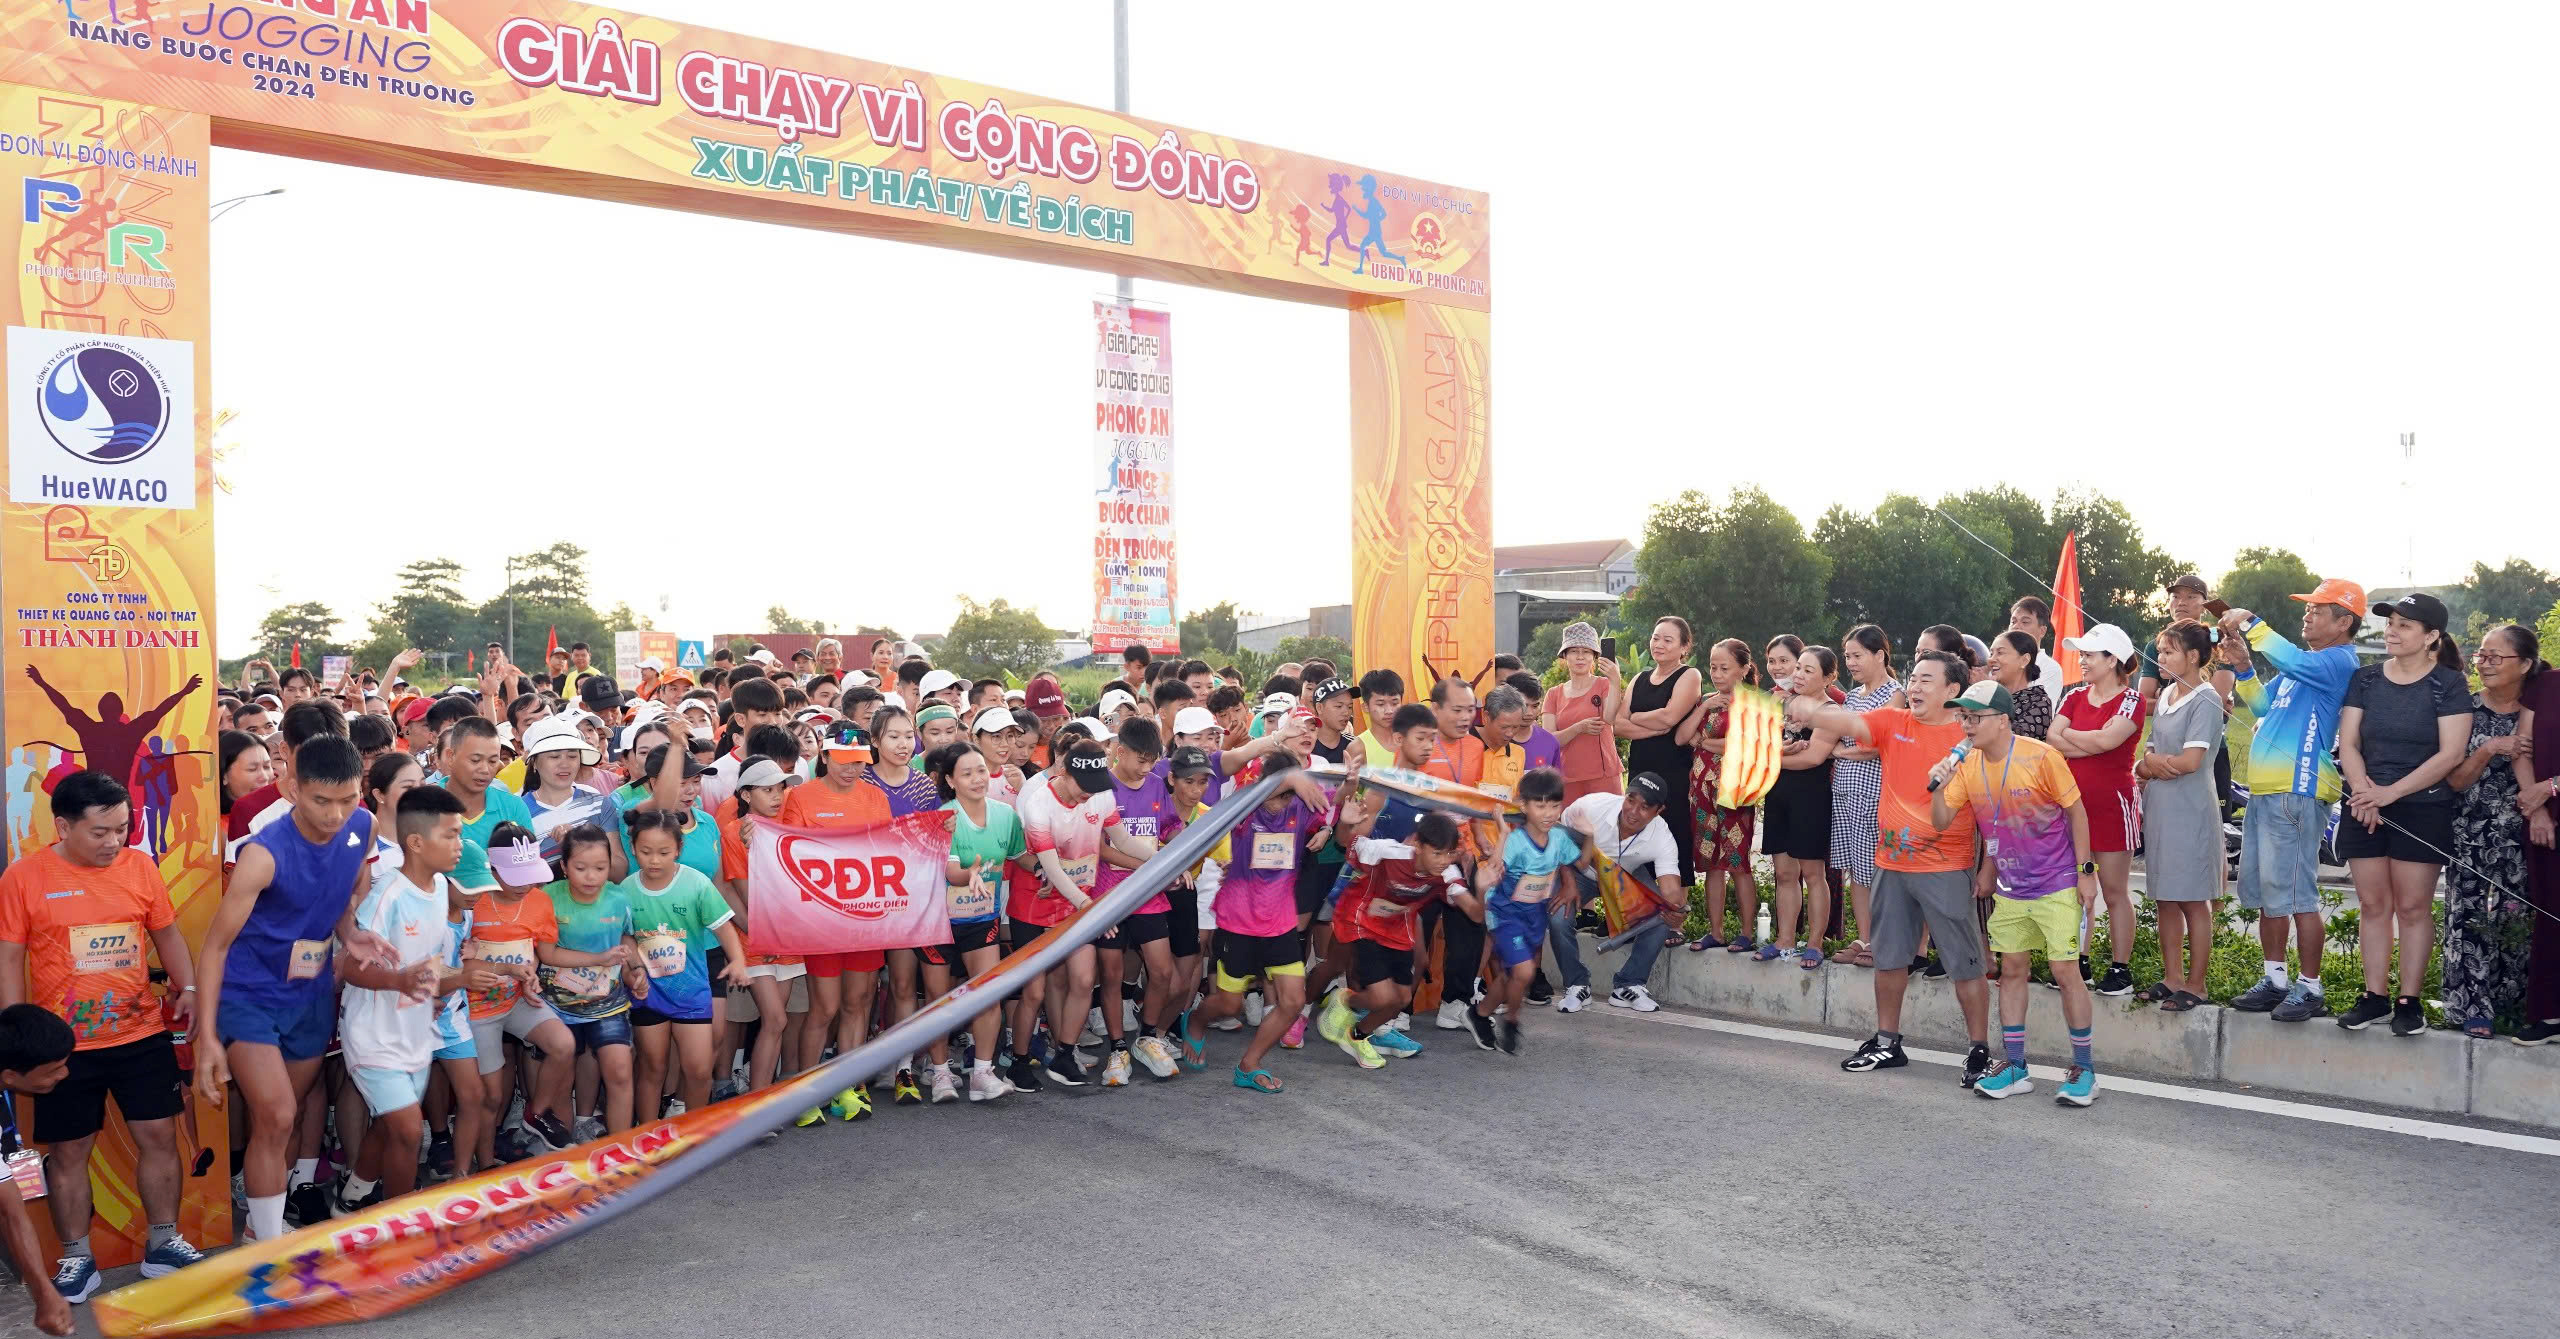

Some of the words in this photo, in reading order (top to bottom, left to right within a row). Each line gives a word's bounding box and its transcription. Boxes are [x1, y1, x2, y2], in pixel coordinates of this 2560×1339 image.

[182, 3, 431, 73] JOGGING
[252, 74, 316, 99] 2024
[497, 17, 661, 106] GIẢI
[676, 50, 853, 142] CHẠY
[857, 80, 927, 152] VÌ
[939, 97, 1101, 183] CỘNG
[1109, 130, 1260, 213] ĐỒNG
[78, 139, 136, 169] ĐỒNG
[143, 151, 198, 178] HÀNH
[692, 137, 834, 196] XUẤT
[976, 181, 1034, 231] VỀ
[1035, 190, 1134, 246] ĐÍCH
[1371, 263, 1405, 282] UBND
[1427, 272, 1466, 293] PHONG
[1469, 280, 1485, 296] AN
[1424, 332, 1457, 431] AN
[1096, 402, 1146, 434] PHONG
[1149, 407, 1169, 437] AN
[42, 474, 168, 503] HueWACO
[1425, 437, 1459, 661] PHONG
[1138, 566, 1166, 579] 10KM)
[102, 593, 114, 604] TY
[117, 593, 148, 604] TNHH
[19, 623, 118, 649] THÀNH
[124, 628, 200, 649] DANH
[1135, 823, 1157, 836] 2024
[843, 901, 881, 911] PHONG
[89, 935, 126, 949] 6777
[115, 959, 131, 967] 6KM
